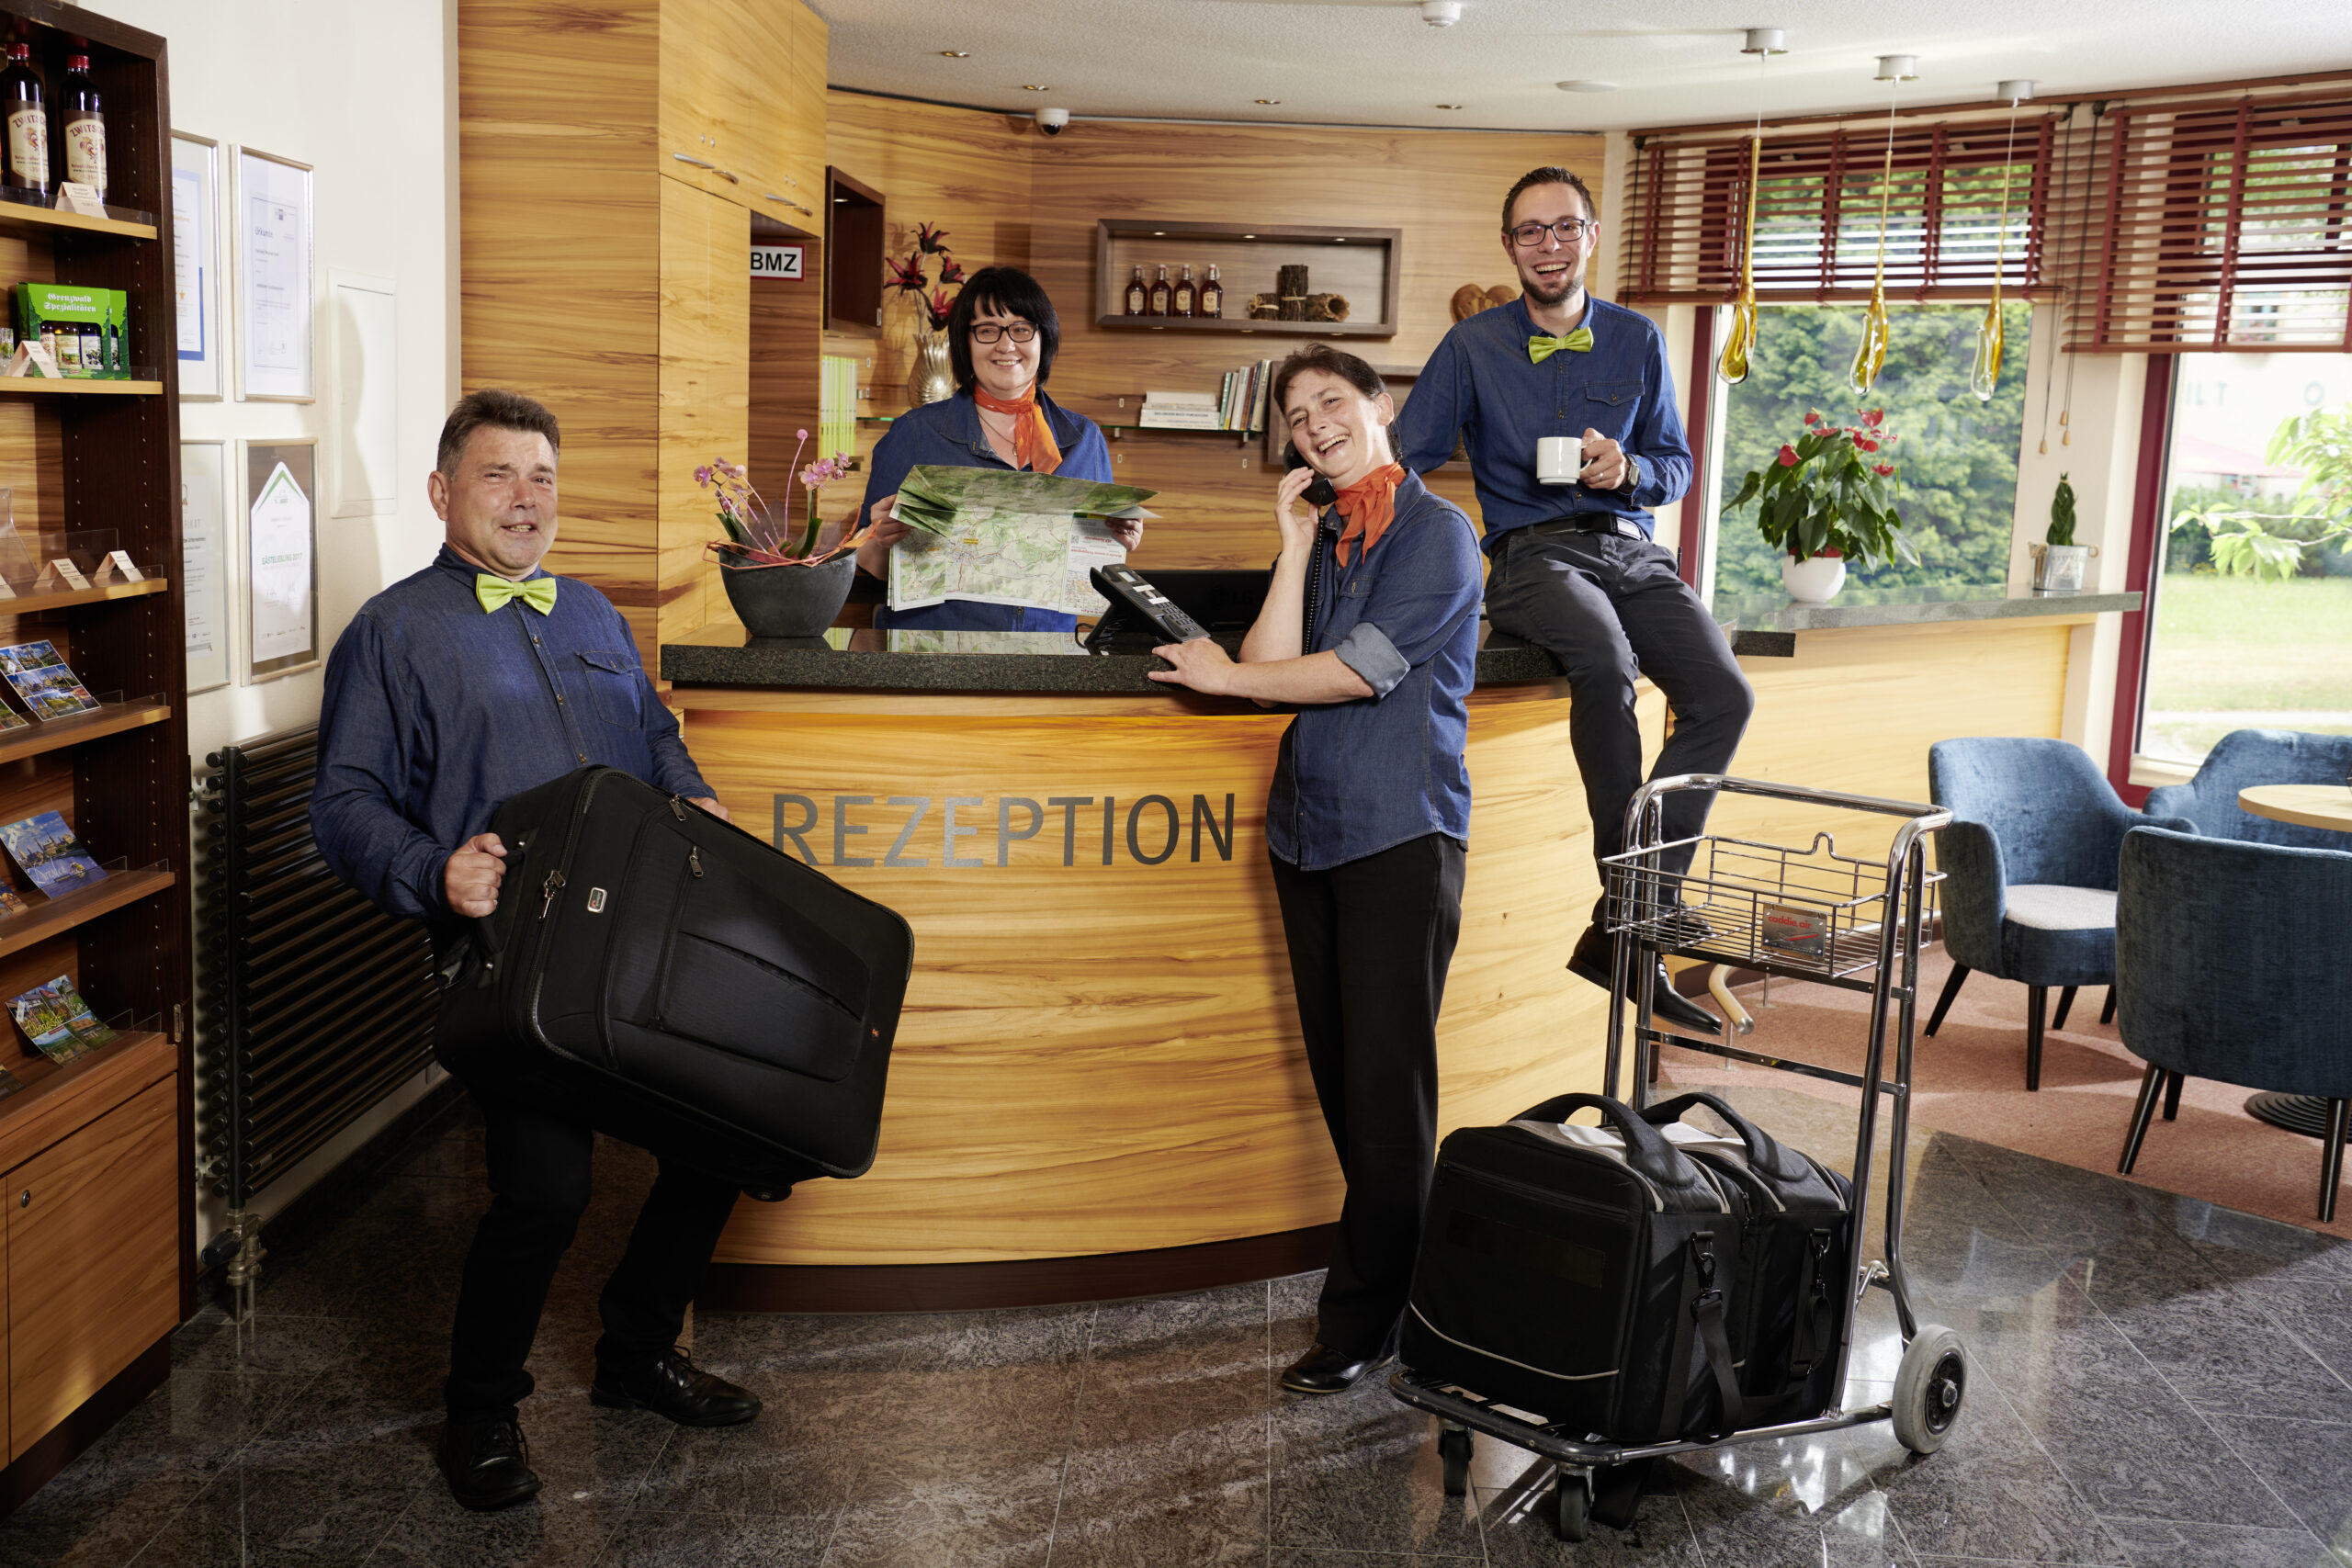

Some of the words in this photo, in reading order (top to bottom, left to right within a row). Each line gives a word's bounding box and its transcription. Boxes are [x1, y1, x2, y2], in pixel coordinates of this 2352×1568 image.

[750, 252, 797, 272] BMZ
[47, 293, 92, 304] Grenzwald
[43, 301, 96, 312] Spezialitäten
[773, 793, 1235, 867] REZEPTION
[1768, 915, 1797, 927] caddie
[1799, 920, 1812, 929] air
